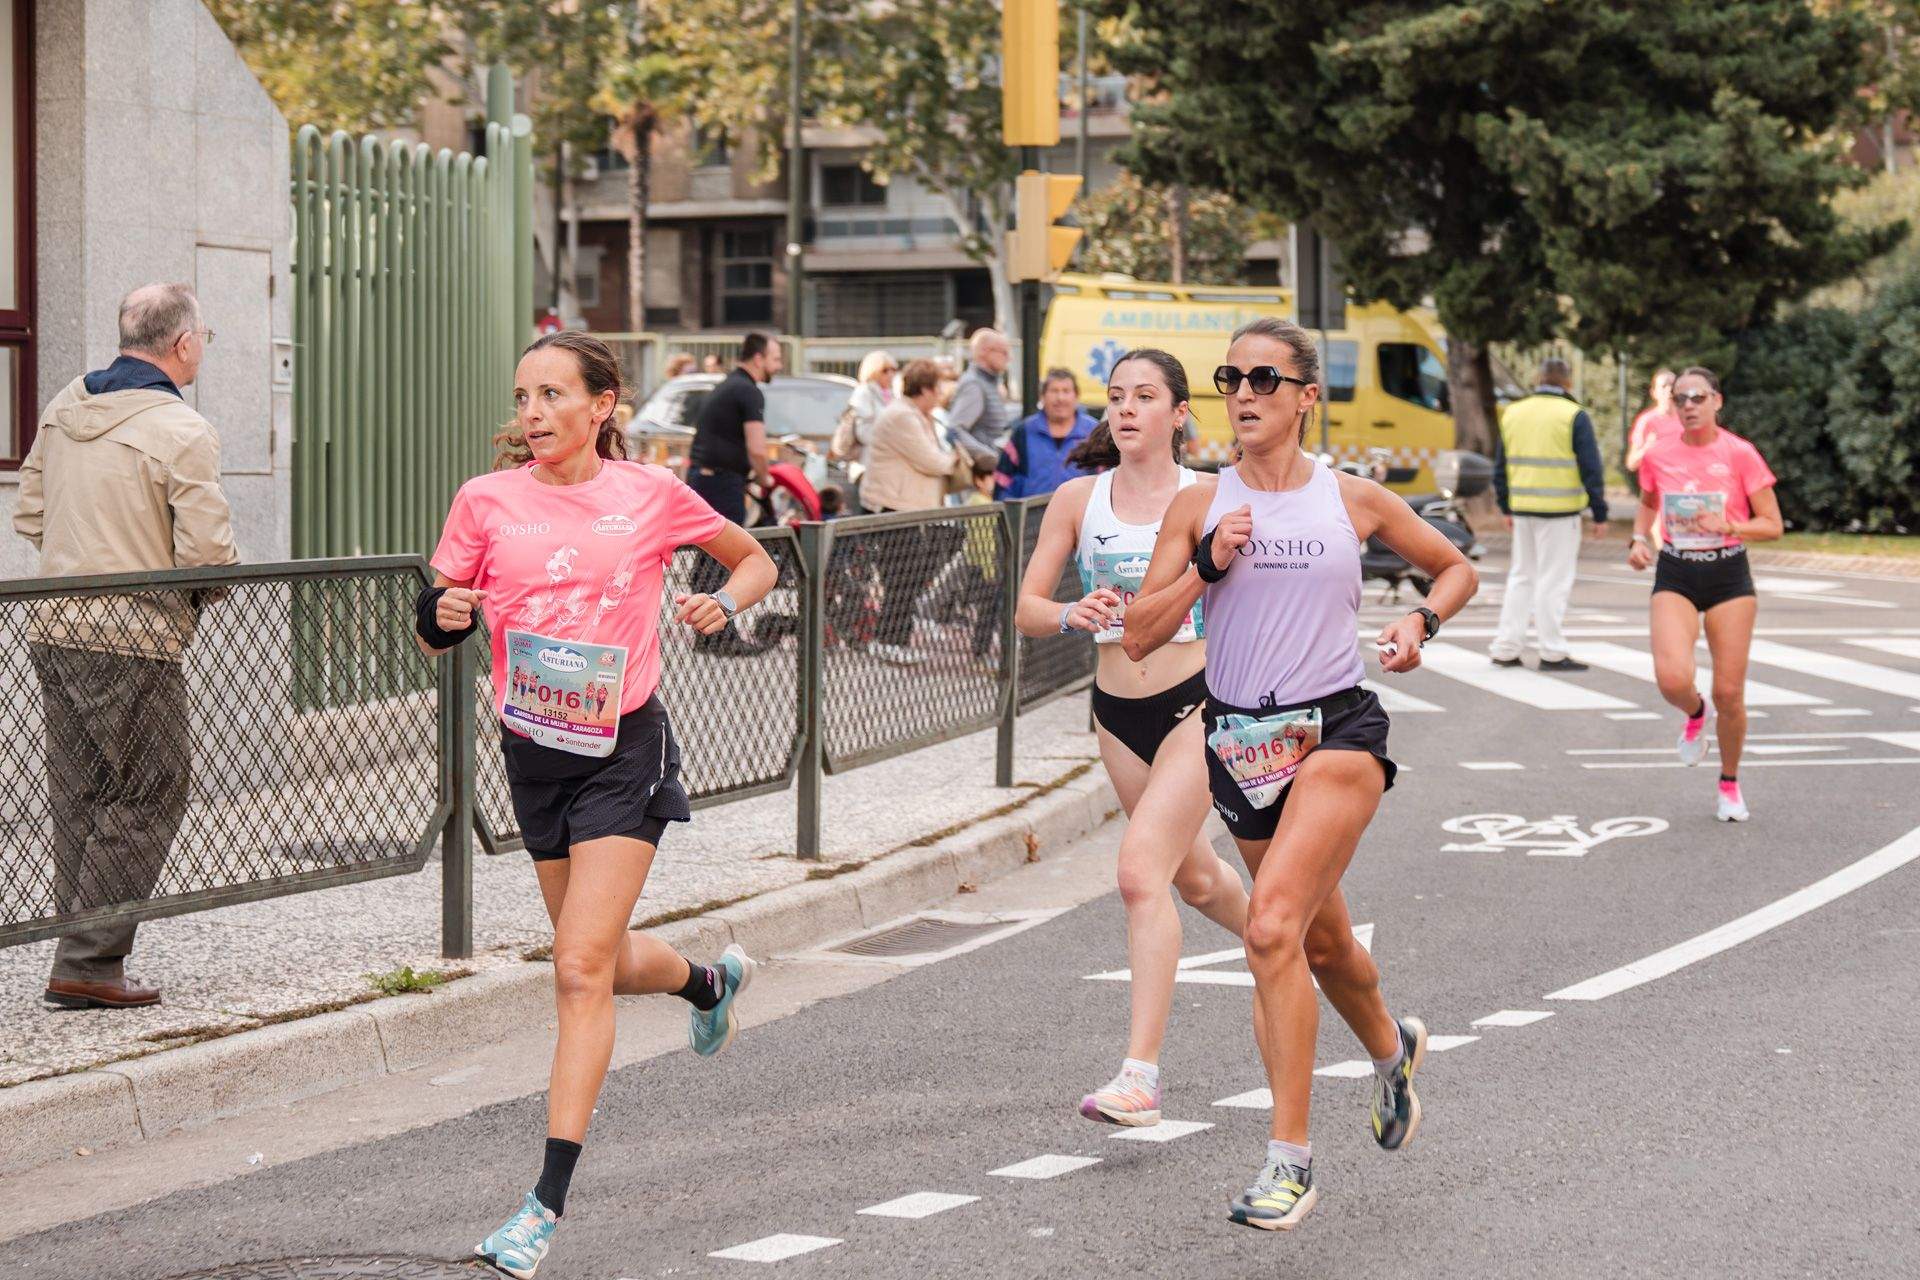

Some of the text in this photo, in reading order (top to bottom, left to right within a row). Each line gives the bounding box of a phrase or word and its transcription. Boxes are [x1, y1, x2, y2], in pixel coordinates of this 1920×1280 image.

[500, 522, 551, 537] OYSHO
[1238, 539, 1325, 557] OYSHO
[1681, 549, 1719, 562] PRO
[1253, 562, 1310, 570] RUNNING CLUB
[541, 652, 585, 669] ASTURIANA
[538, 686, 581, 709] 016
[543, 708, 568, 720] 13152
[534, 714, 542, 724] DE
[542, 716, 550, 725] LA
[550, 719, 569, 729] MUJER
[572, 724, 604, 735] ZARAGOZA
[565, 737, 602, 750] Santander
[1245, 737, 1284, 763] 016
